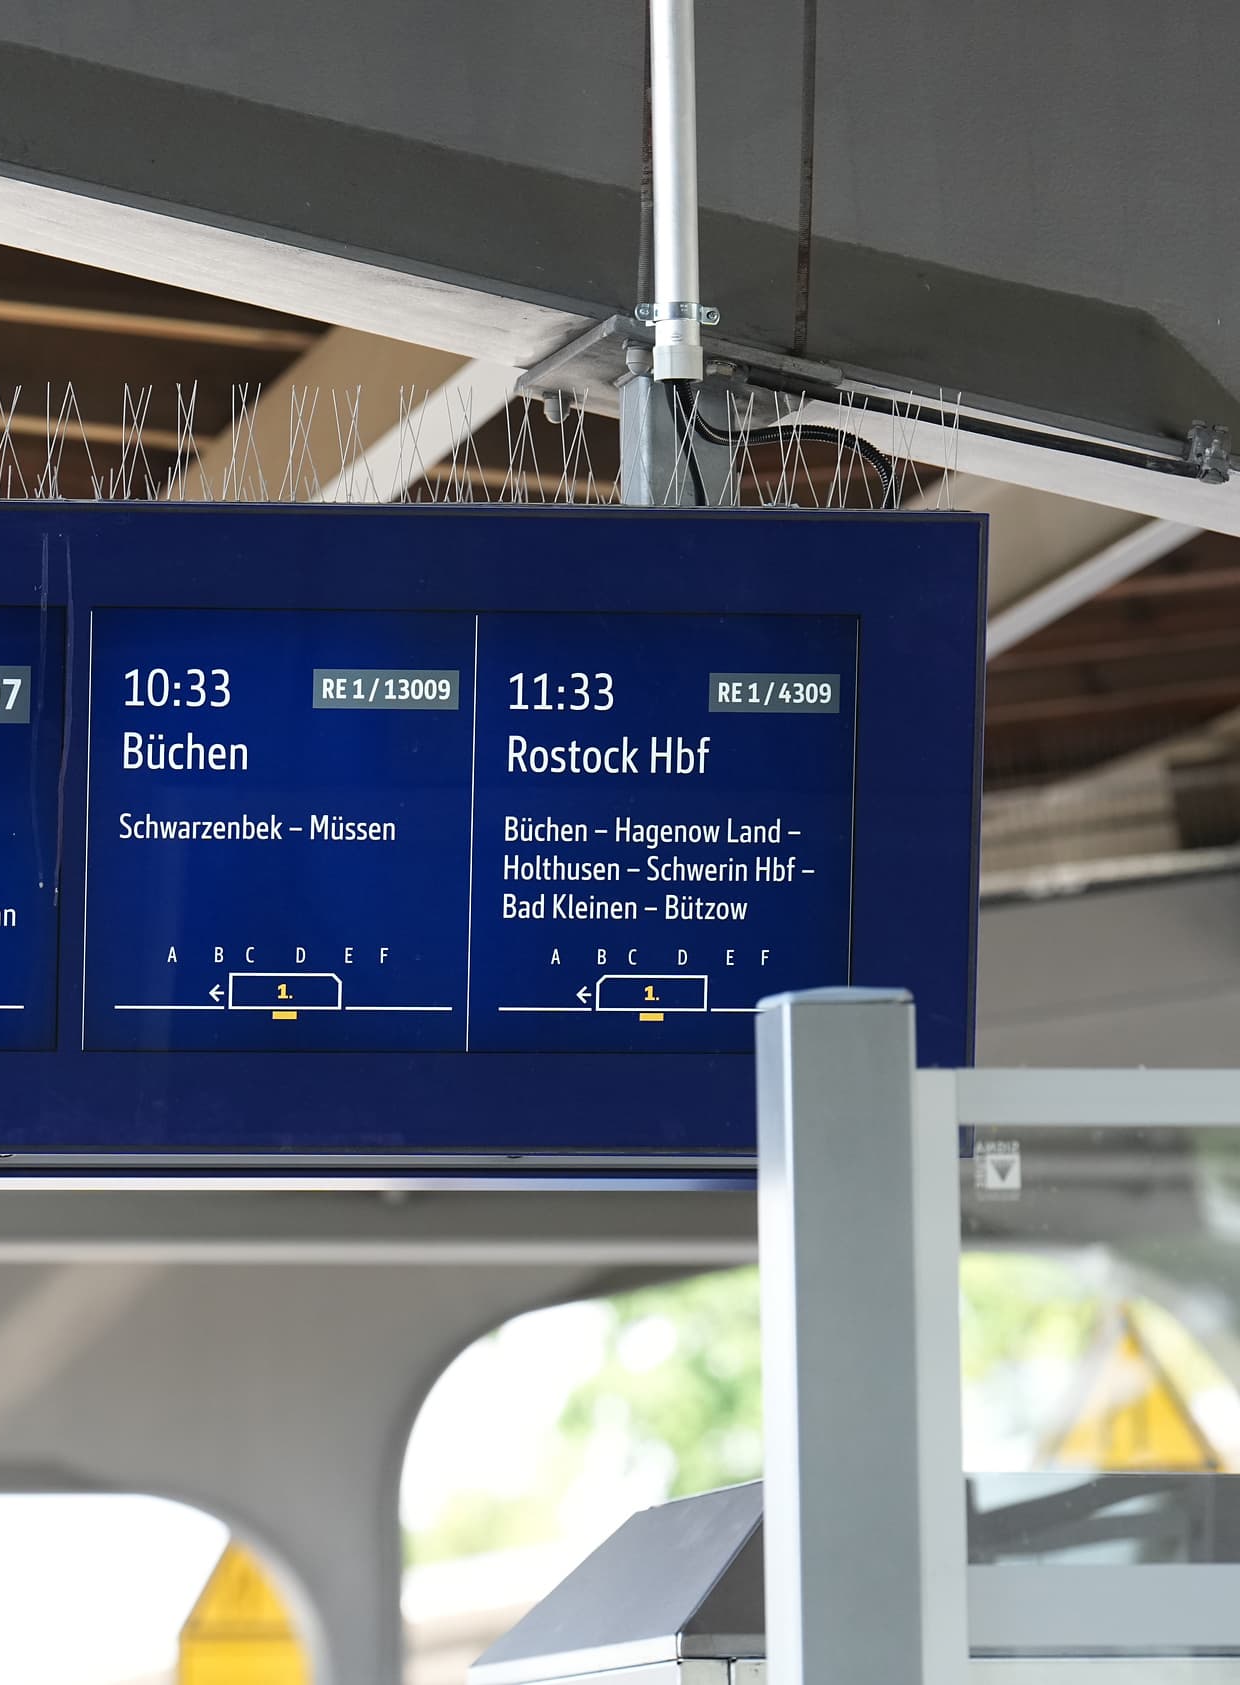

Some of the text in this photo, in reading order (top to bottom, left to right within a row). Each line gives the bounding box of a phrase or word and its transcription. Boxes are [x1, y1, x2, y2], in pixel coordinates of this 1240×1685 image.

[124, 668, 231, 708] 10:33
[322, 678, 347, 699] RE
[509, 672, 614, 711] 11:33
[718, 682, 743, 703] RE
[123, 731, 248, 770] Büchen
[508, 735, 711, 774] Rostock Hbf
[119, 812, 283, 840] Schwarzenbek
[310, 814, 396, 841] Müssen
[504, 815, 588, 842] Büchen
[615, 816, 721, 850] Hagenow
[727, 817, 781, 844] Land
[503, 854, 620, 881] Holthusen
[646, 855, 748, 882] Schwerin
[755, 856, 796, 882] Hbf
[502, 893, 545, 919] Bad
[552, 893, 637, 920] Kleinen
[665, 894, 748, 920] Bützow
[167, 946, 389, 964] A B C D E F
[550, 948, 770, 966] A B C D E F
[277, 983, 293, 999] 1.
[644, 985, 660, 1001] 1.
